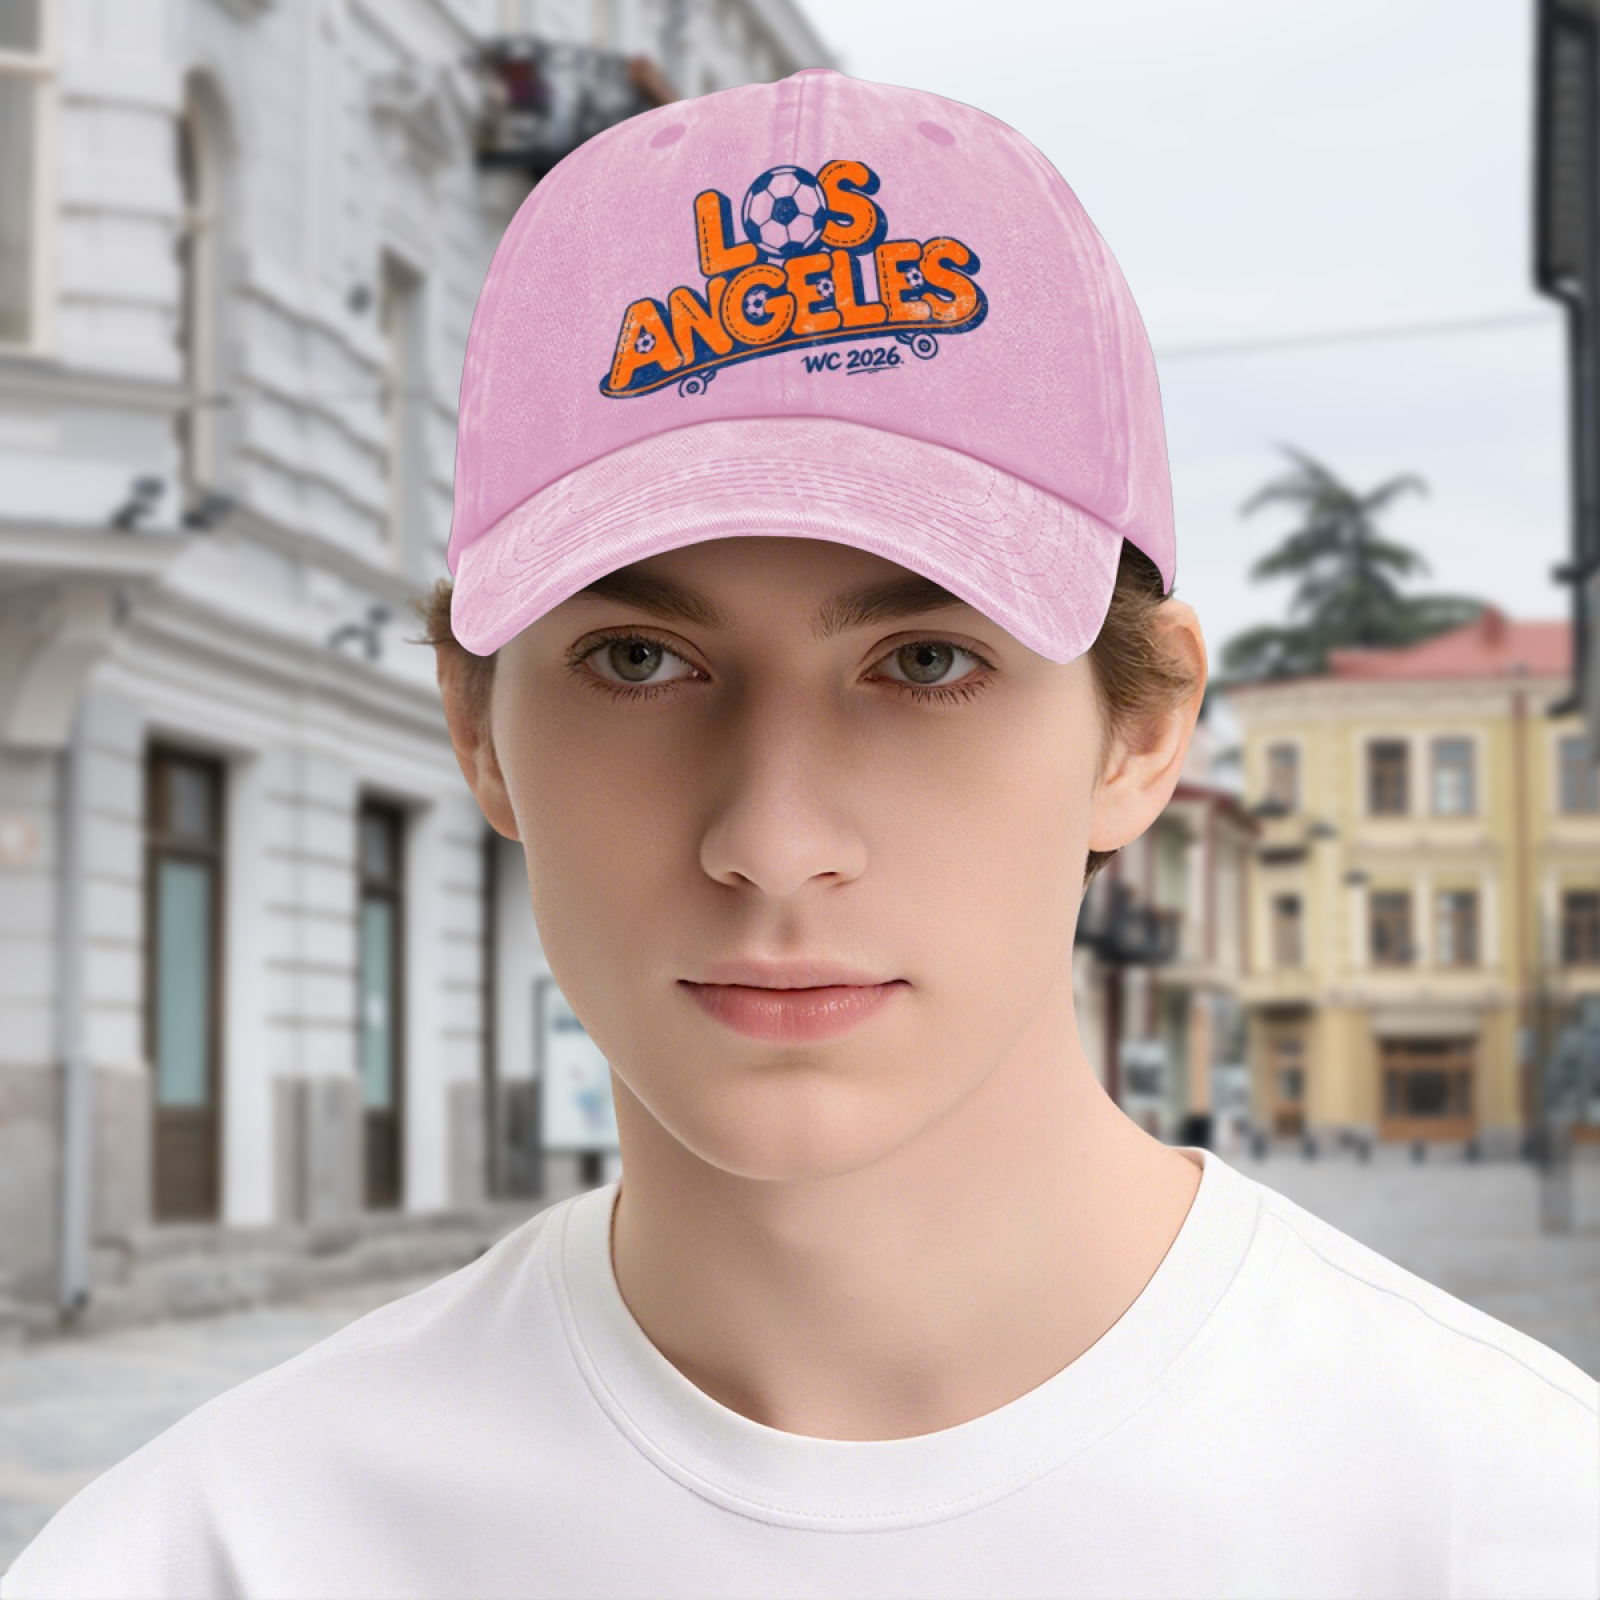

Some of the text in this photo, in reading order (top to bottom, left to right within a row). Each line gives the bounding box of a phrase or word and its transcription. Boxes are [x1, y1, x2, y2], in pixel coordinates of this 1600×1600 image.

[694, 159, 888, 277] LOS
[608, 237, 981, 391] ANGELES
[801, 352, 842, 373] WC
